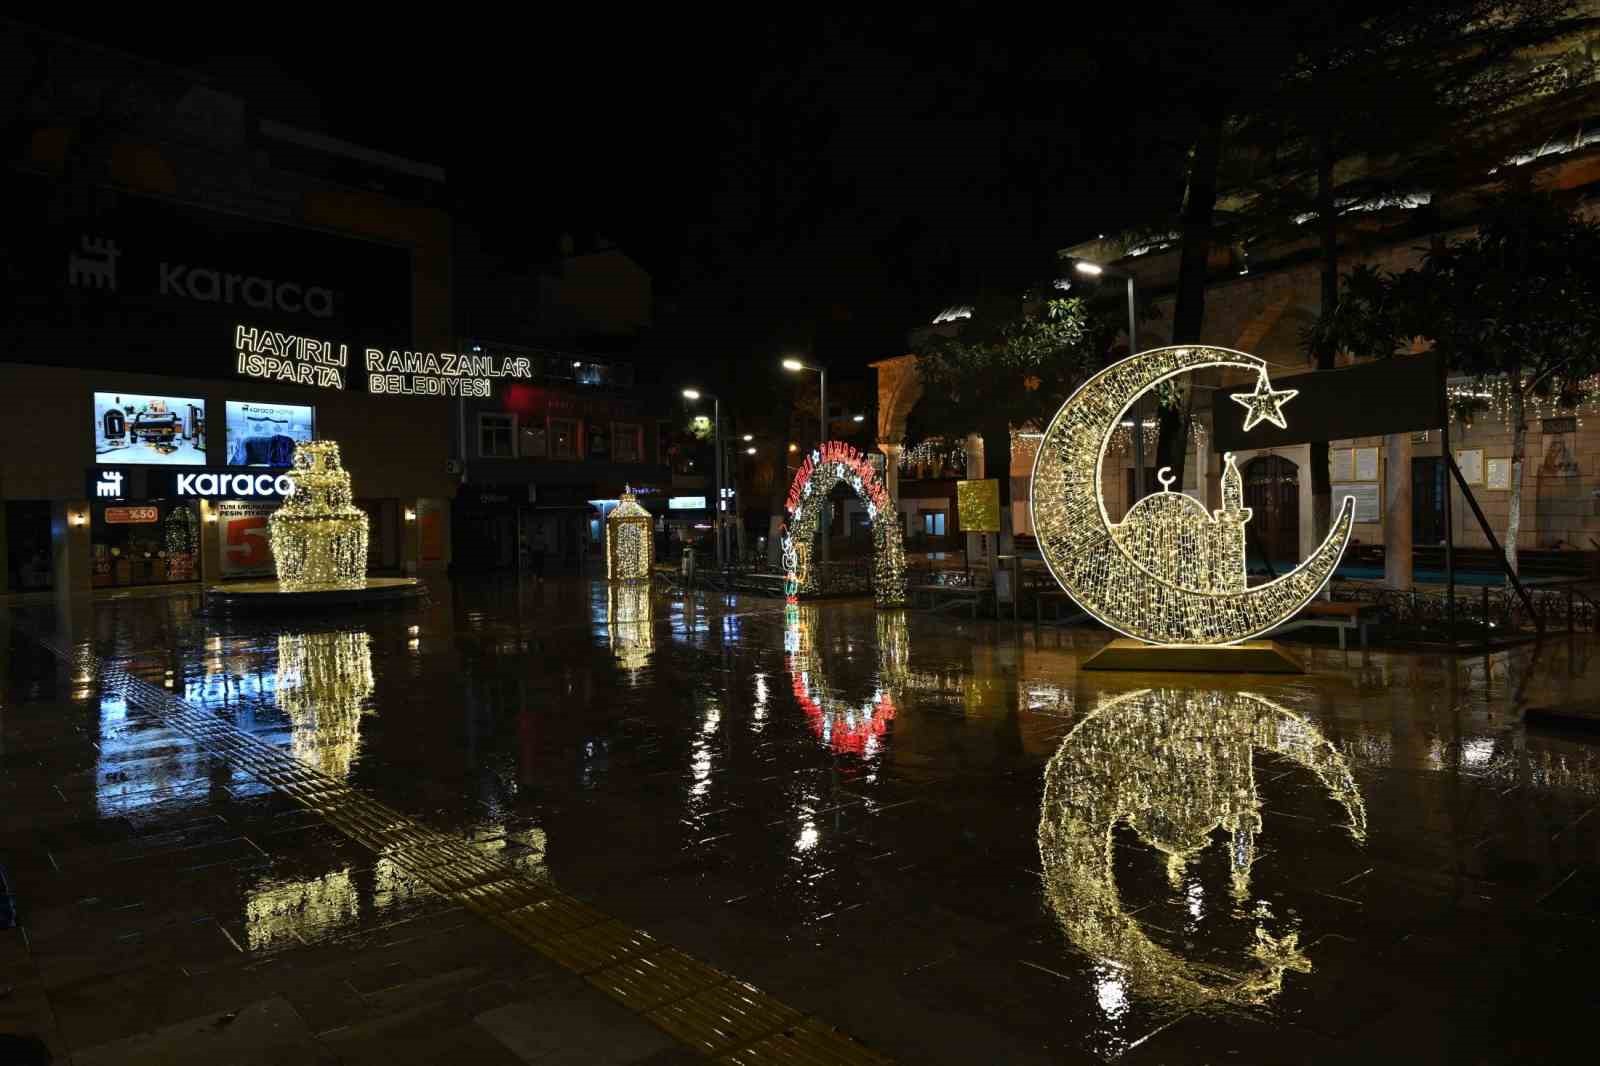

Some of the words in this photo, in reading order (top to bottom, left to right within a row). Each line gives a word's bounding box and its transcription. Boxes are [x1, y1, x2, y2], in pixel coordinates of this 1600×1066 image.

[159, 260, 335, 319] karaca
[235, 325, 348, 367] HAYIRLI
[365, 348, 532, 378] RAMAZANLAR
[237, 352, 344, 389] ISPARTA
[177, 473, 295, 496] karaca
[224, 516, 270, 566] 5
